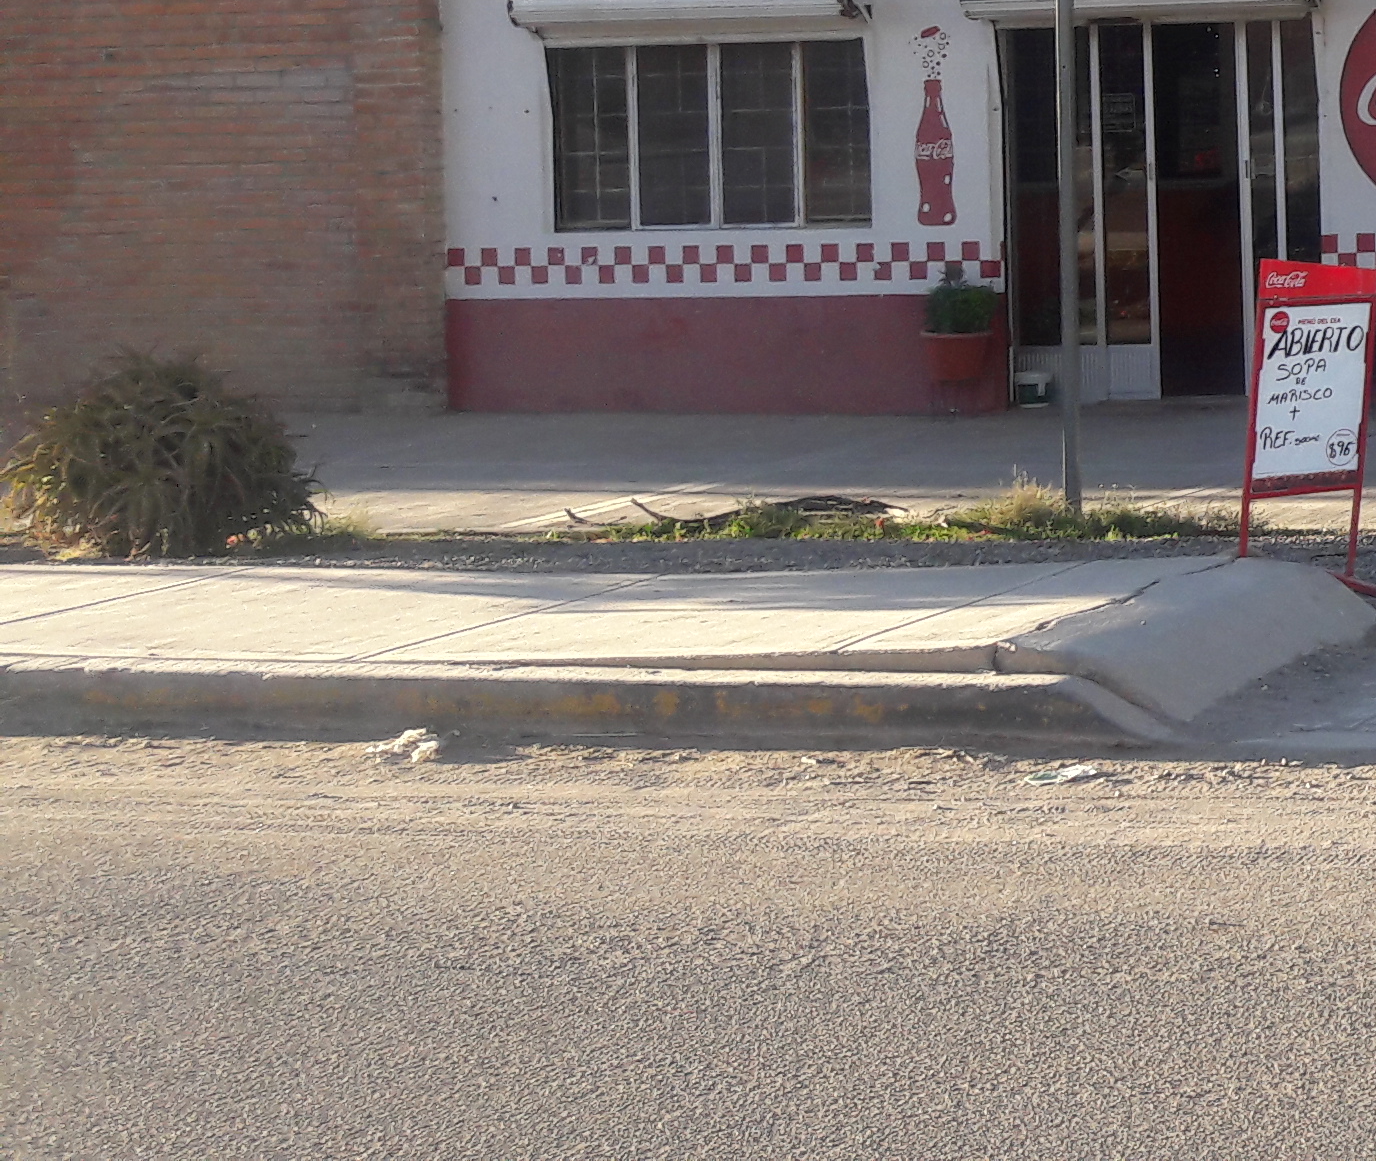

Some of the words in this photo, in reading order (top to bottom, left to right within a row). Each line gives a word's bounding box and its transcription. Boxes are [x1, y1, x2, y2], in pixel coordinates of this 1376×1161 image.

[1267, 325, 1364, 360] ABIERTO
[1276, 358, 1327, 381] SOPA
[1267, 387, 1333, 404] MARISCO
